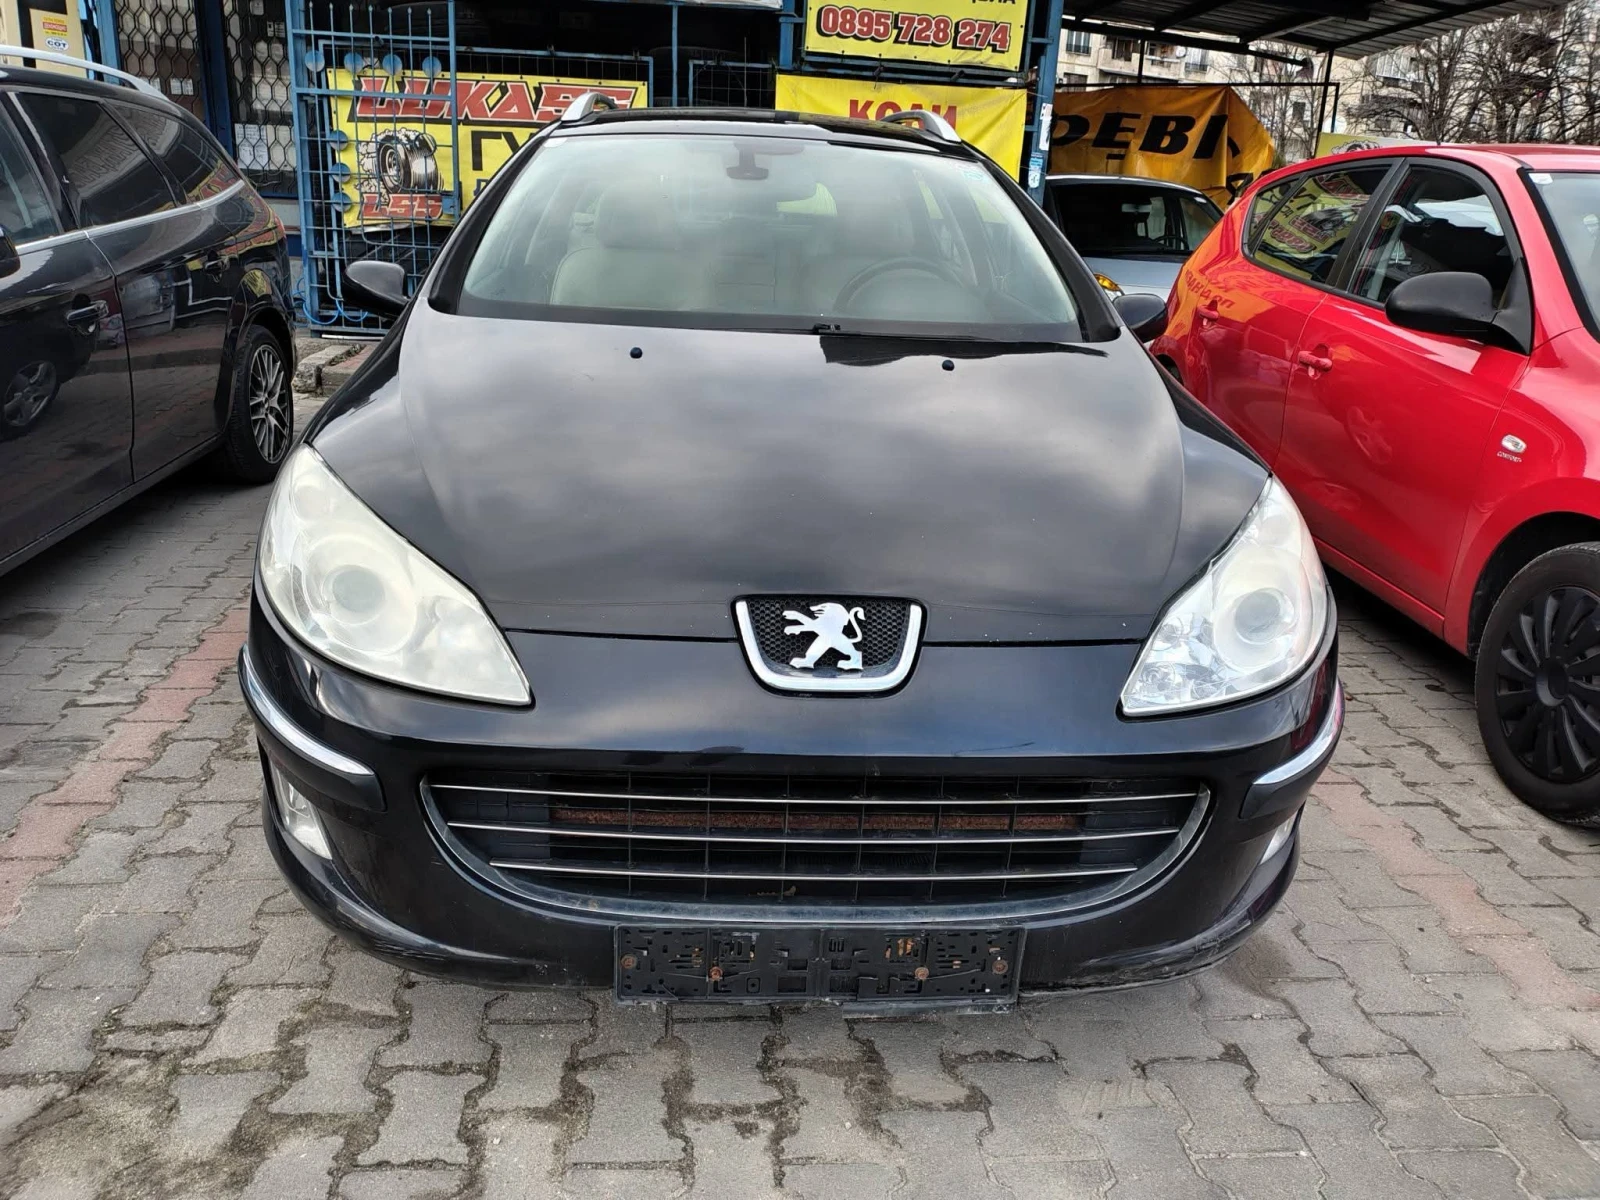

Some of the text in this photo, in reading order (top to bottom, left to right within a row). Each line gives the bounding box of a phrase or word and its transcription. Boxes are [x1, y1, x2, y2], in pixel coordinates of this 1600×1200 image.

[818, 5, 1011, 53] 0895 728 274
[1051, 111, 1240, 160] DEBI
[360, 192, 443, 220] LSS
